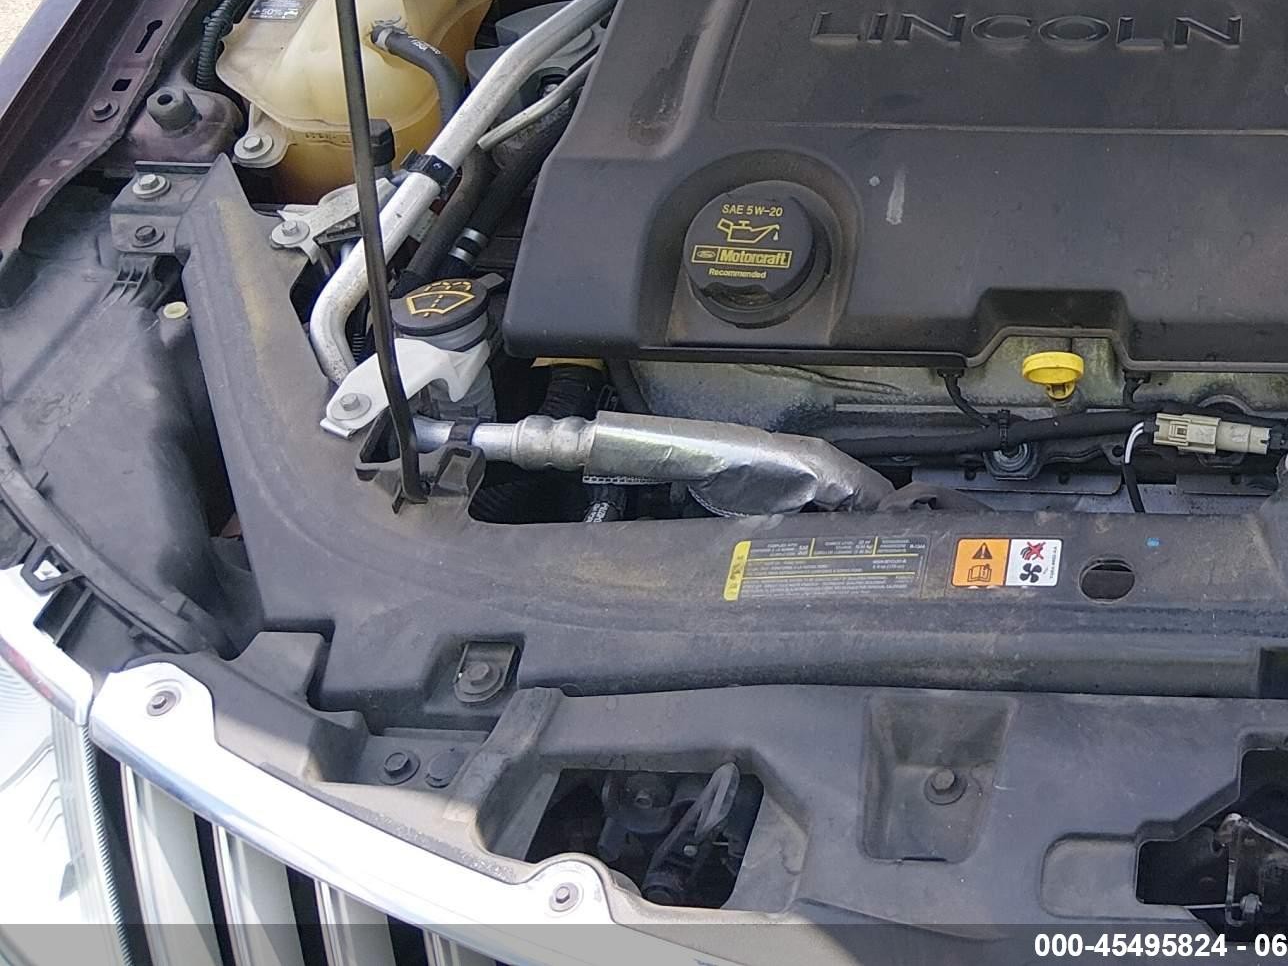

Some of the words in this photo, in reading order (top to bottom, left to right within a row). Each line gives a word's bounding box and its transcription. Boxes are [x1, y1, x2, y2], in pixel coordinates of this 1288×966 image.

[810, 10, 1244, 52] LINCOLN
[721, 203, 745, 216] SAE
[747, 204, 784, 217] 5W-20
[719, 250, 788, 266] Motorcraft
[708, 267, 767, 279] Recommended
